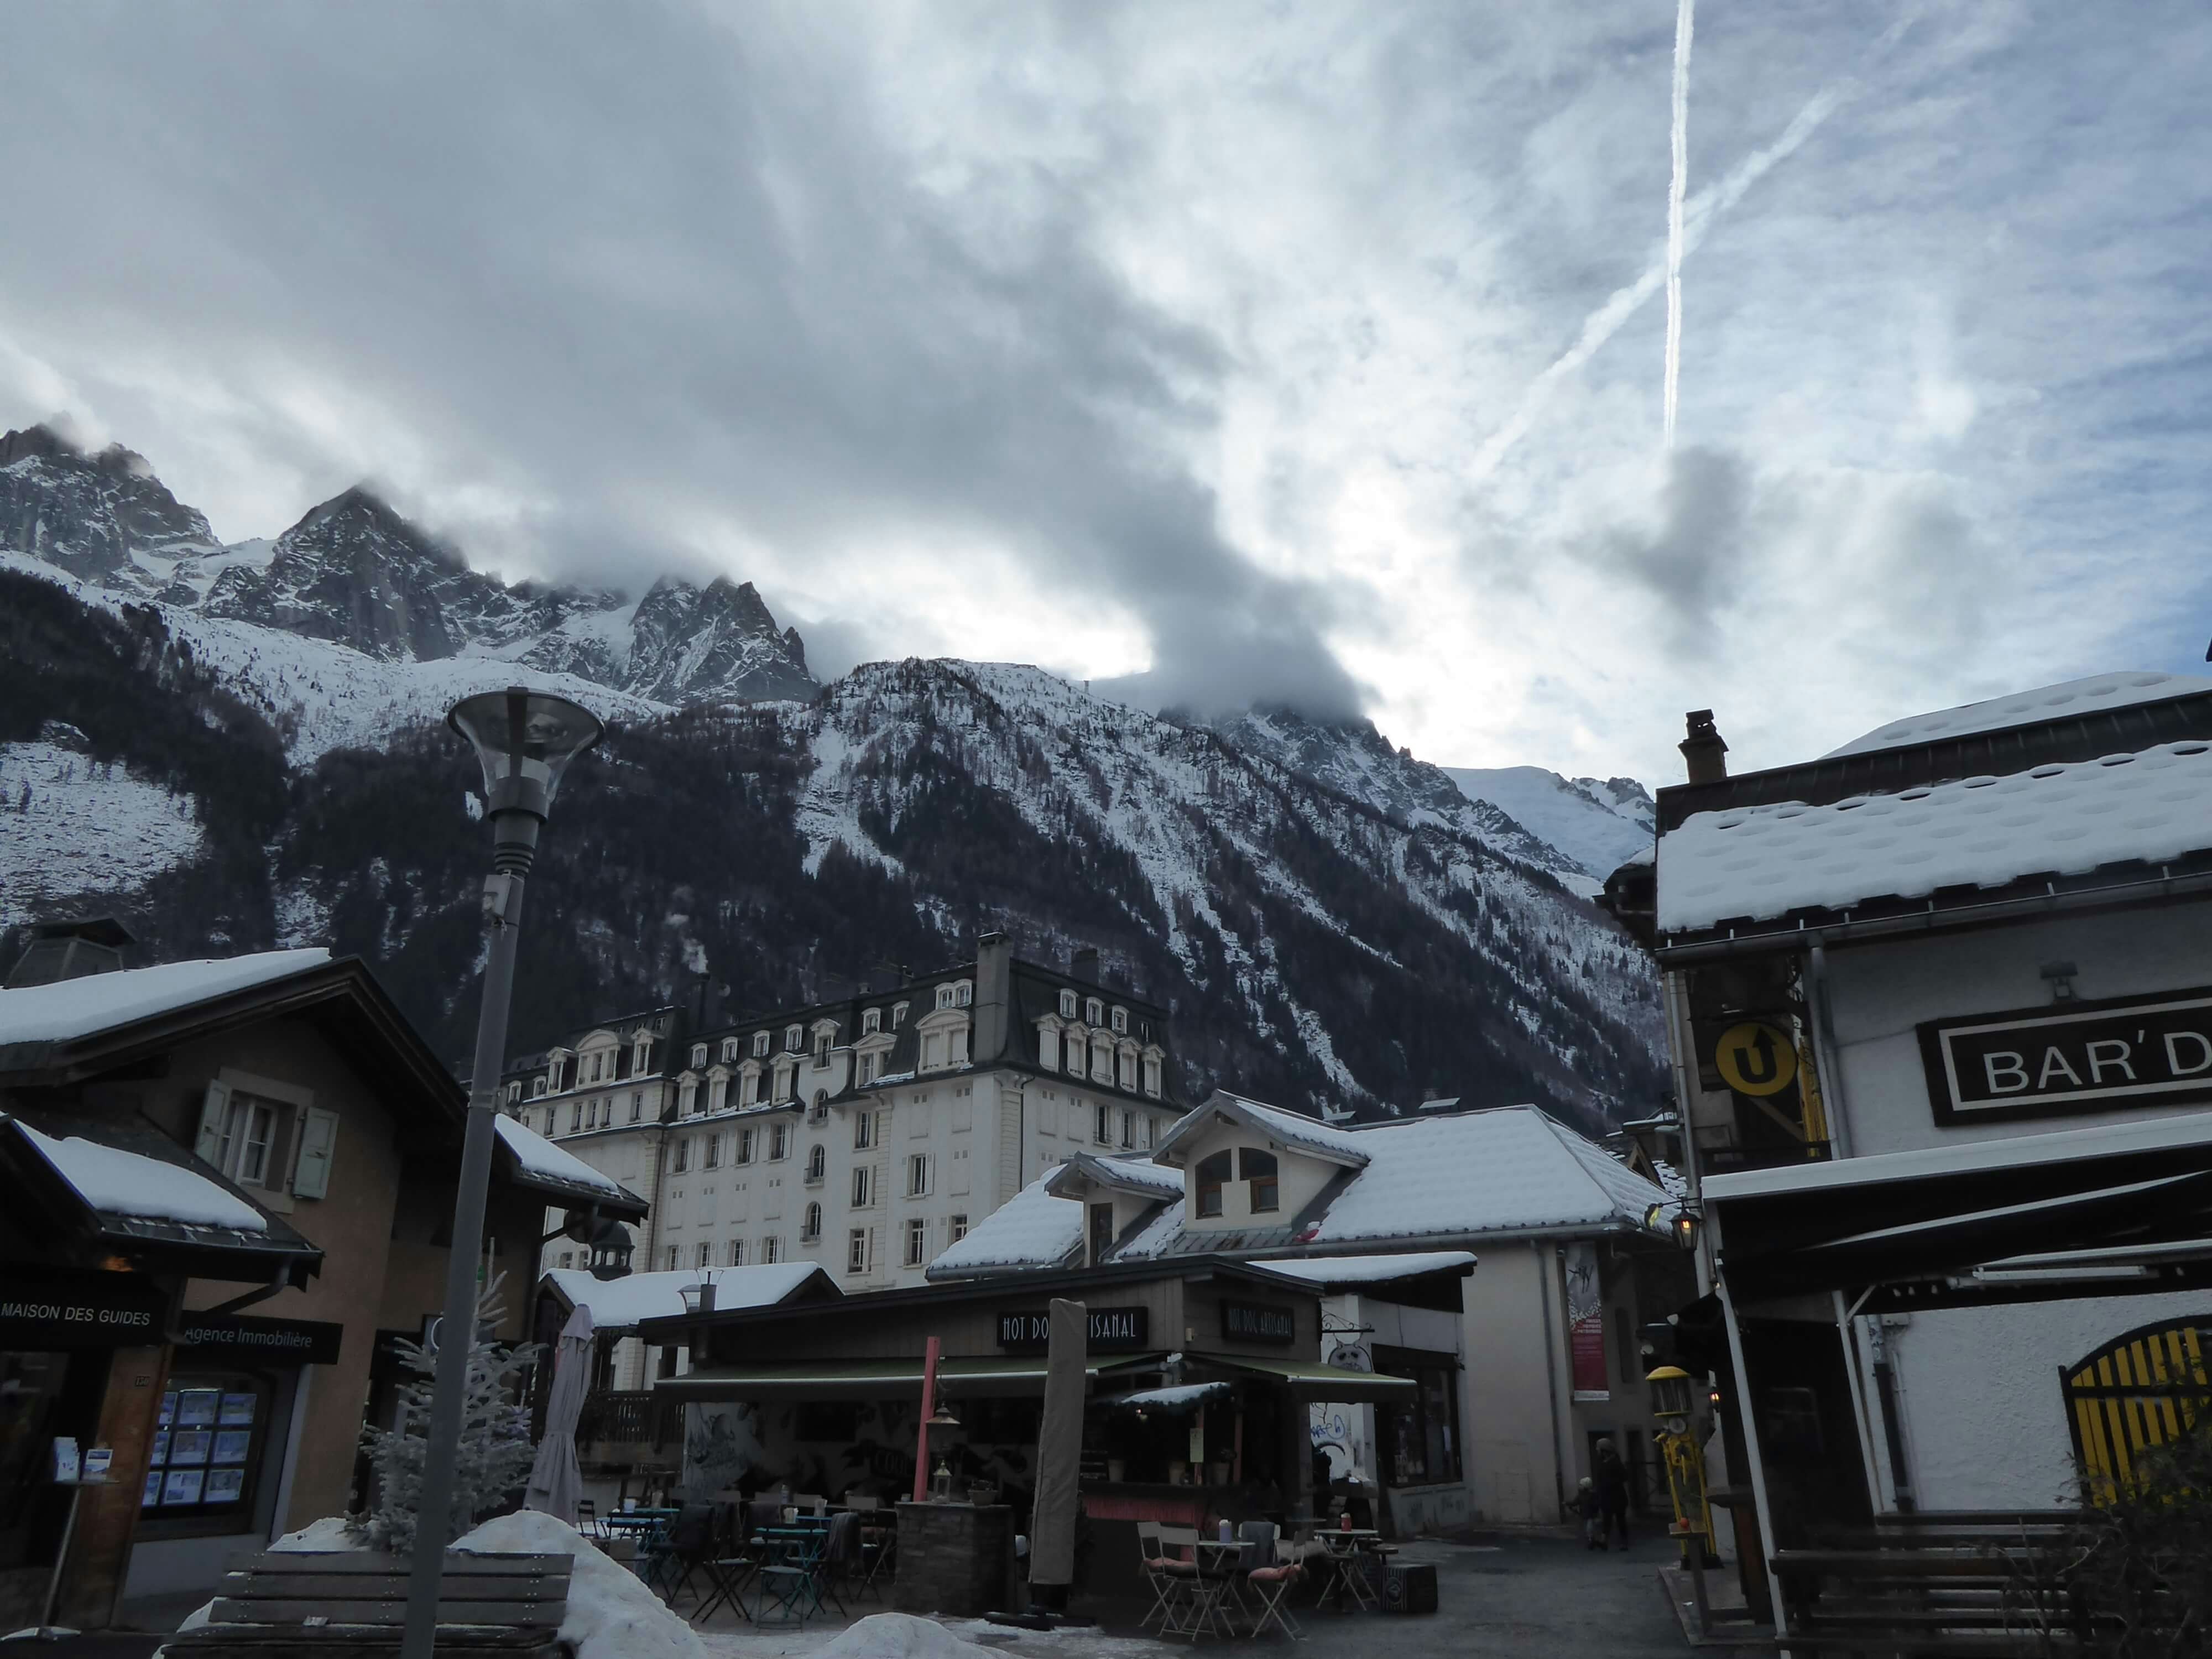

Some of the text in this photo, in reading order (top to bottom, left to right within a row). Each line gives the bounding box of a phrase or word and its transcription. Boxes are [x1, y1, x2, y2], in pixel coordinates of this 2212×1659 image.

[1, 1302, 152, 1327] MAISON DES GUIDES
[1003, 1313, 1136, 1341] HOT DO ISANAL
[185, 1327, 313, 1348] Agence Immobilière
